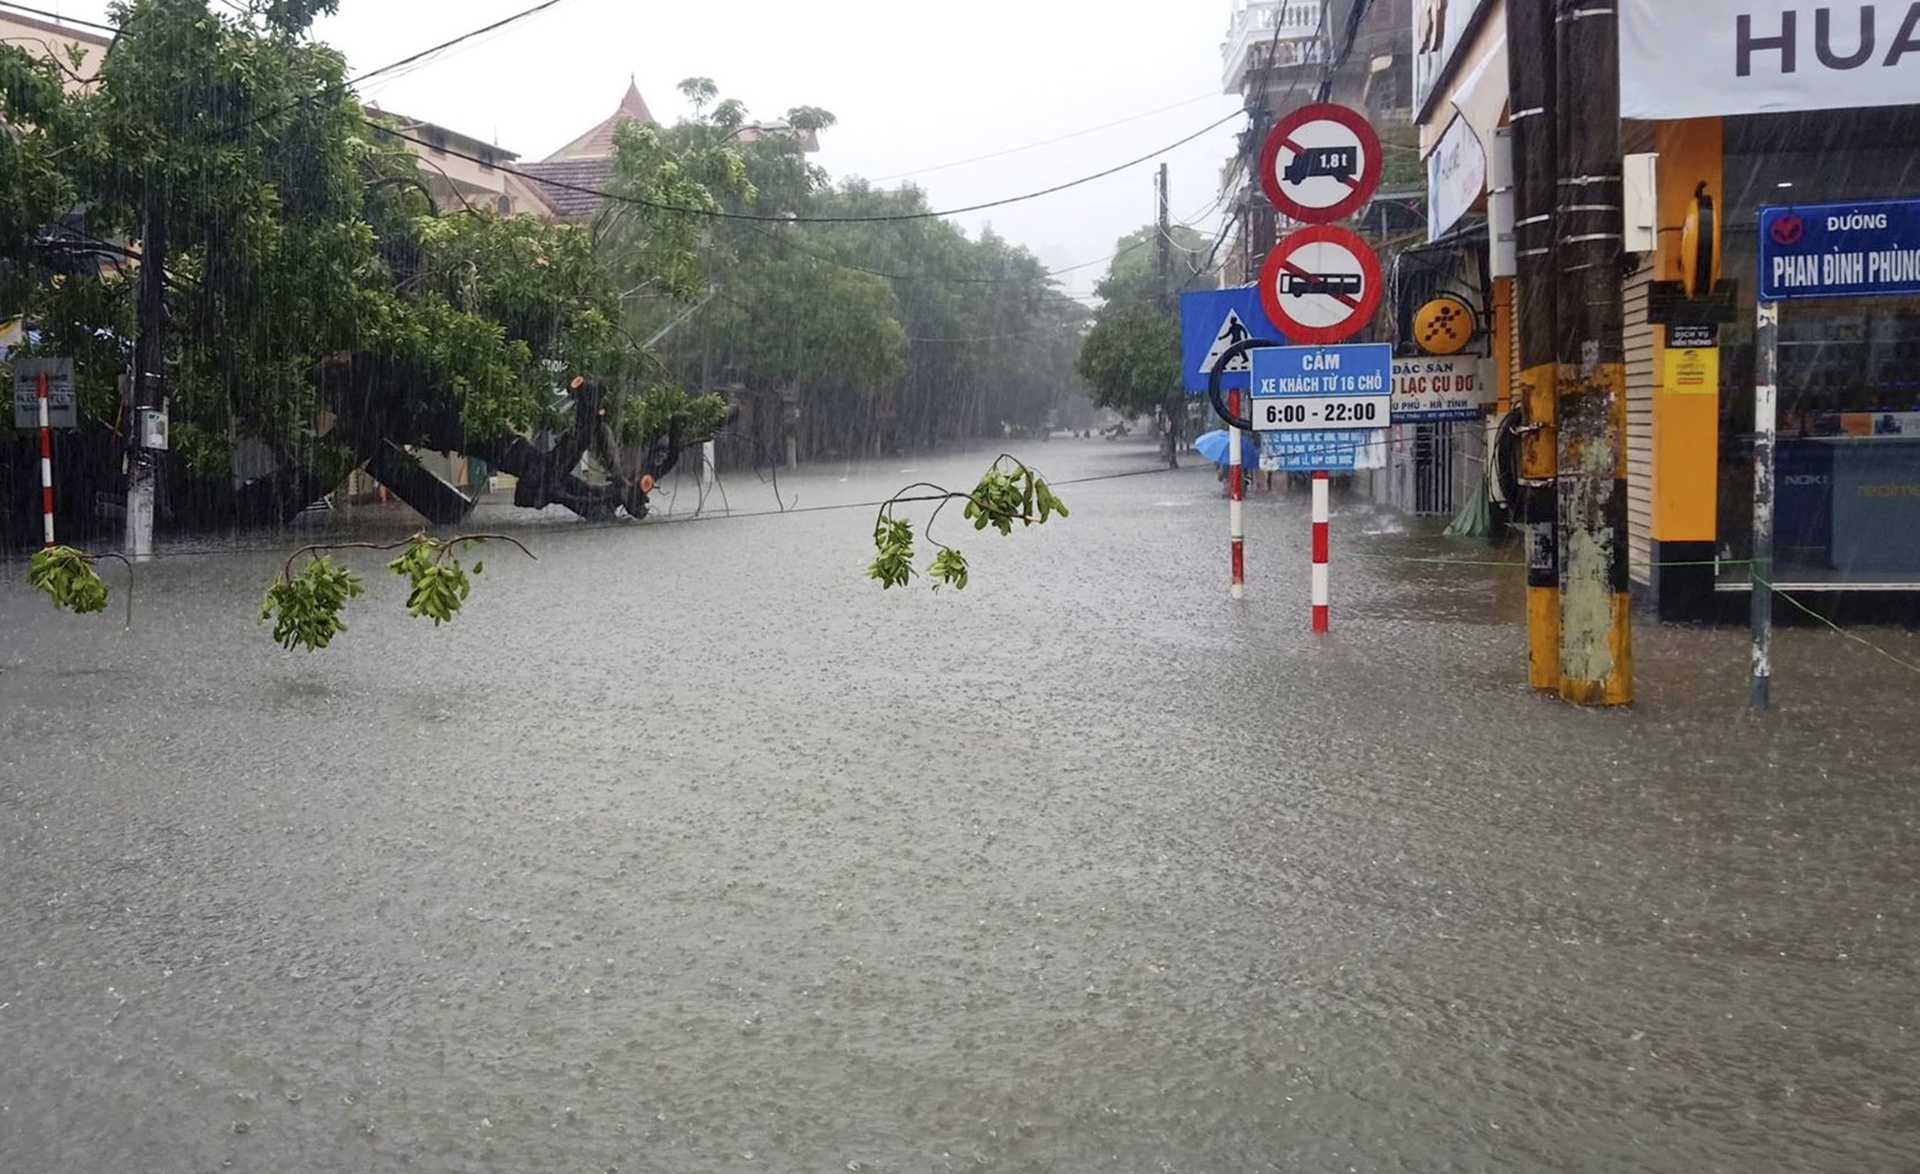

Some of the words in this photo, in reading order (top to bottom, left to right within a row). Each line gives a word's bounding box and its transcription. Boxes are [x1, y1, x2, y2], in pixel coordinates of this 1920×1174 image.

[1828, 210, 1887, 231] ĐƯỜNG
[1773, 254, 1818, 288] PHAN
[1823, 246, 1863, 285] ĐÌNH
[1302, 348, 1340, 371] CẤM
[1261, 378, 1276, 394] XE
[1280, 374, 1319, 393] KHÁCH
[1323, 372, 1339, 392] TỪ
[1341, 375, 1355, 392] 16
[1358, 369, 1383, 391] CHỖ
[1400, 377, 1427, 397] LẠC
[1432, 374, 1451, 393] CU
[1266, 404, 1306, 424] 6:00
[1325, 402, 1376, 422] 22:00
